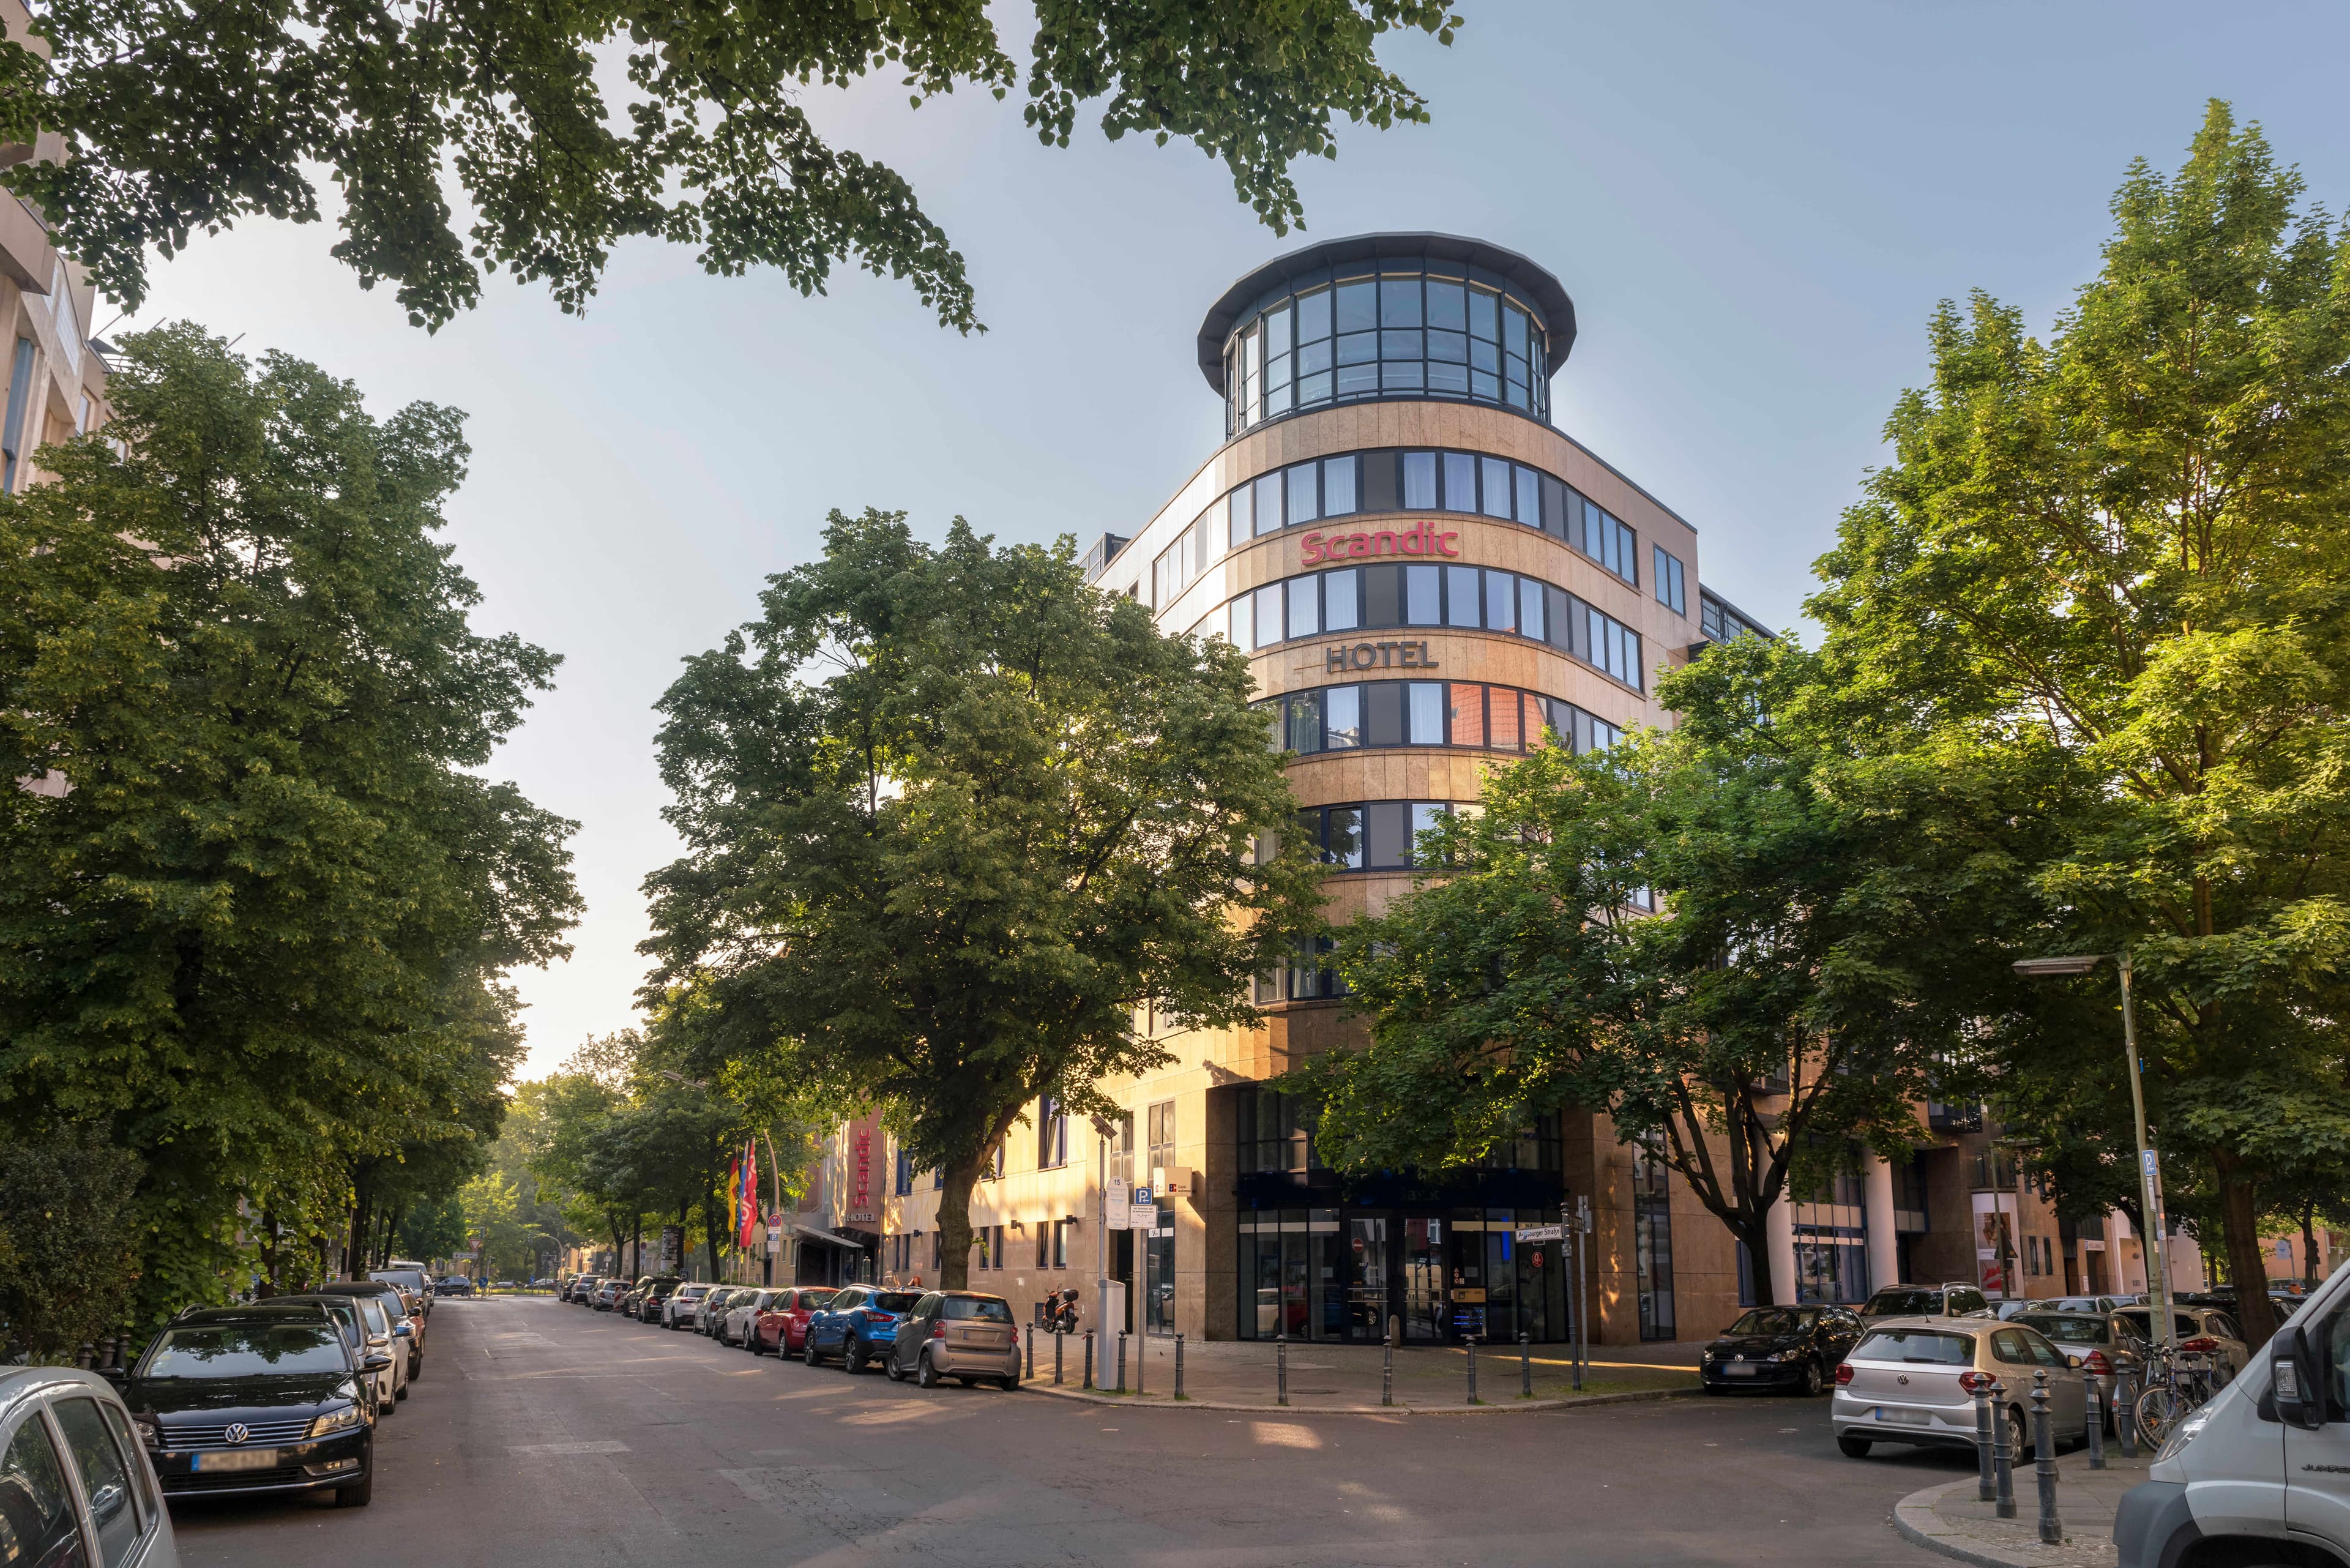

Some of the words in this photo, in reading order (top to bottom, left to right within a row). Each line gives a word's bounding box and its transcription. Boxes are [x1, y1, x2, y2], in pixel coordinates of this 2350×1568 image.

[1301, 521, 1459, 566] Scandic
[1326, 641, 1439, 673] HOTEL
[853, 1128, 871, 1209] Scandic
[846, 1213, 876, 1223] HOTEL
